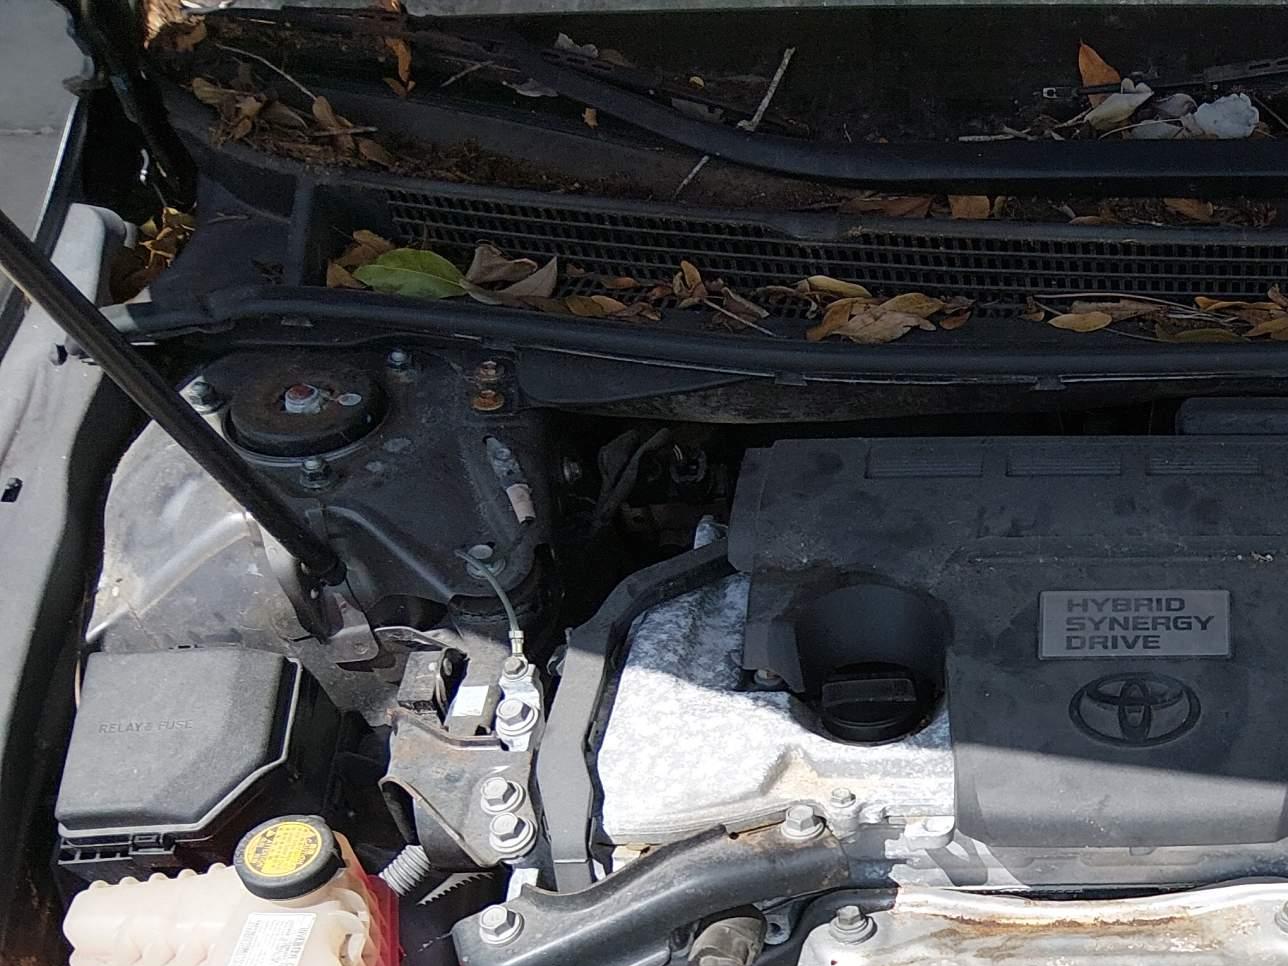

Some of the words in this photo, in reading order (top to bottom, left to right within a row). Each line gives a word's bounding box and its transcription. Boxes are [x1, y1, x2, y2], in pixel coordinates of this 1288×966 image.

[1066, 598, 1186, 613] HYBRID
[1065, 616, 1214, 632] SYNERGY
[1065, 635, 1161, 650] DRIVE
[98, 723, 142, 734] RELAY
[157, 720, 194, 731] FUSE
